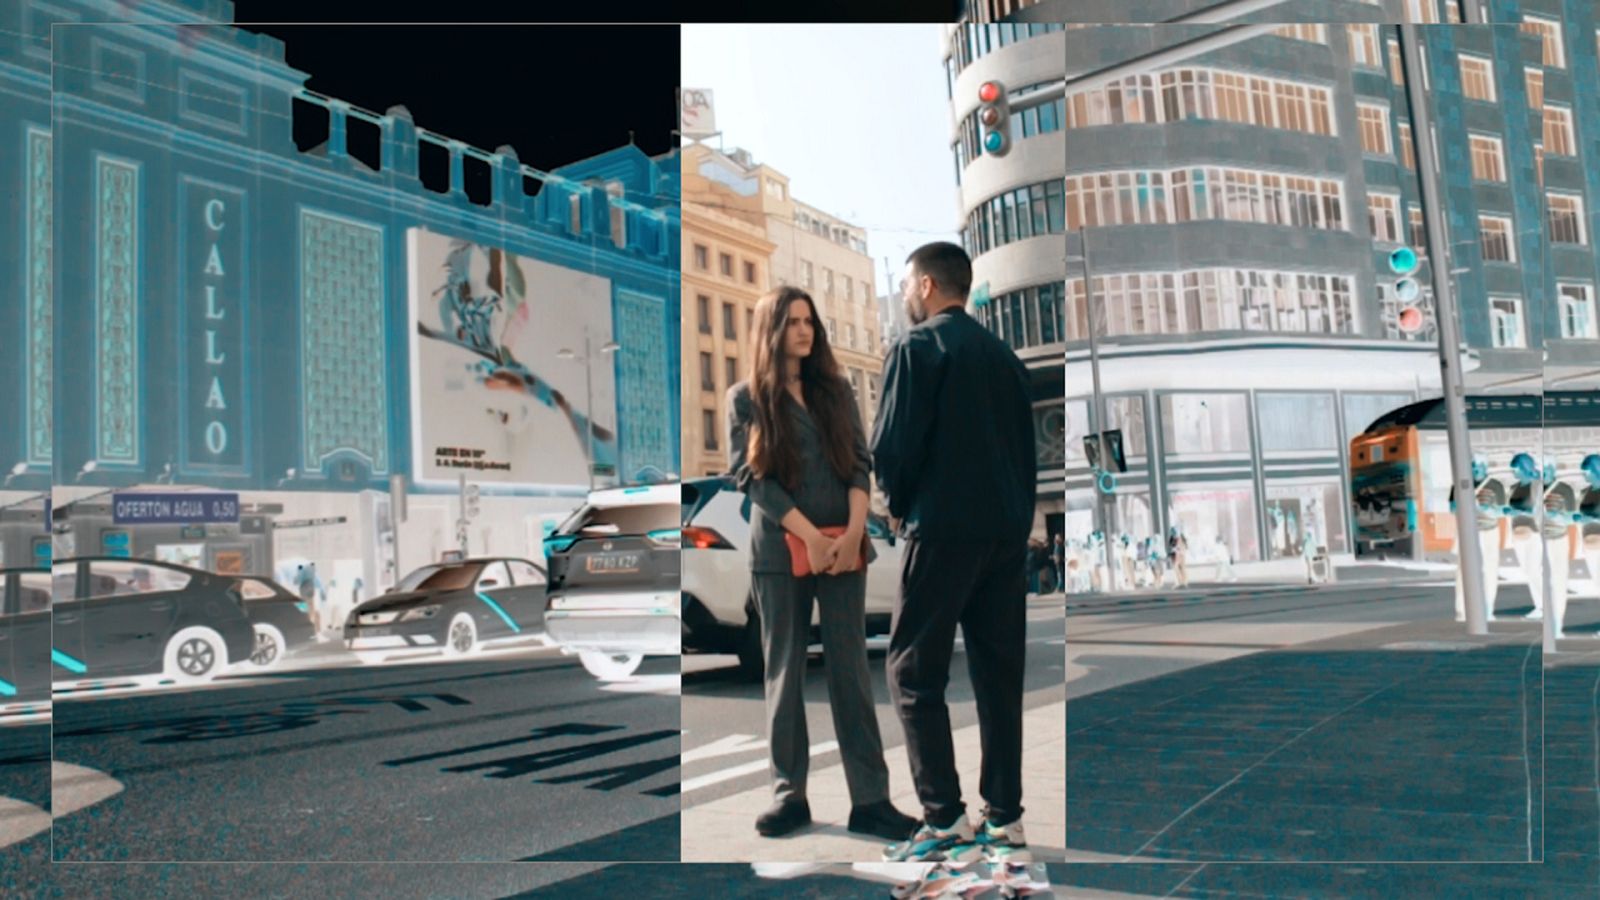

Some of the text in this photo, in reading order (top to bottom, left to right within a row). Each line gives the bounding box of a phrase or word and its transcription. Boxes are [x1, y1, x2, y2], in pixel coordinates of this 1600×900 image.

[204, 199, 227, 454] CALLAO
[116, 500, 170, 518] OFERTON
[173, 500, 204, 518] AGUA
